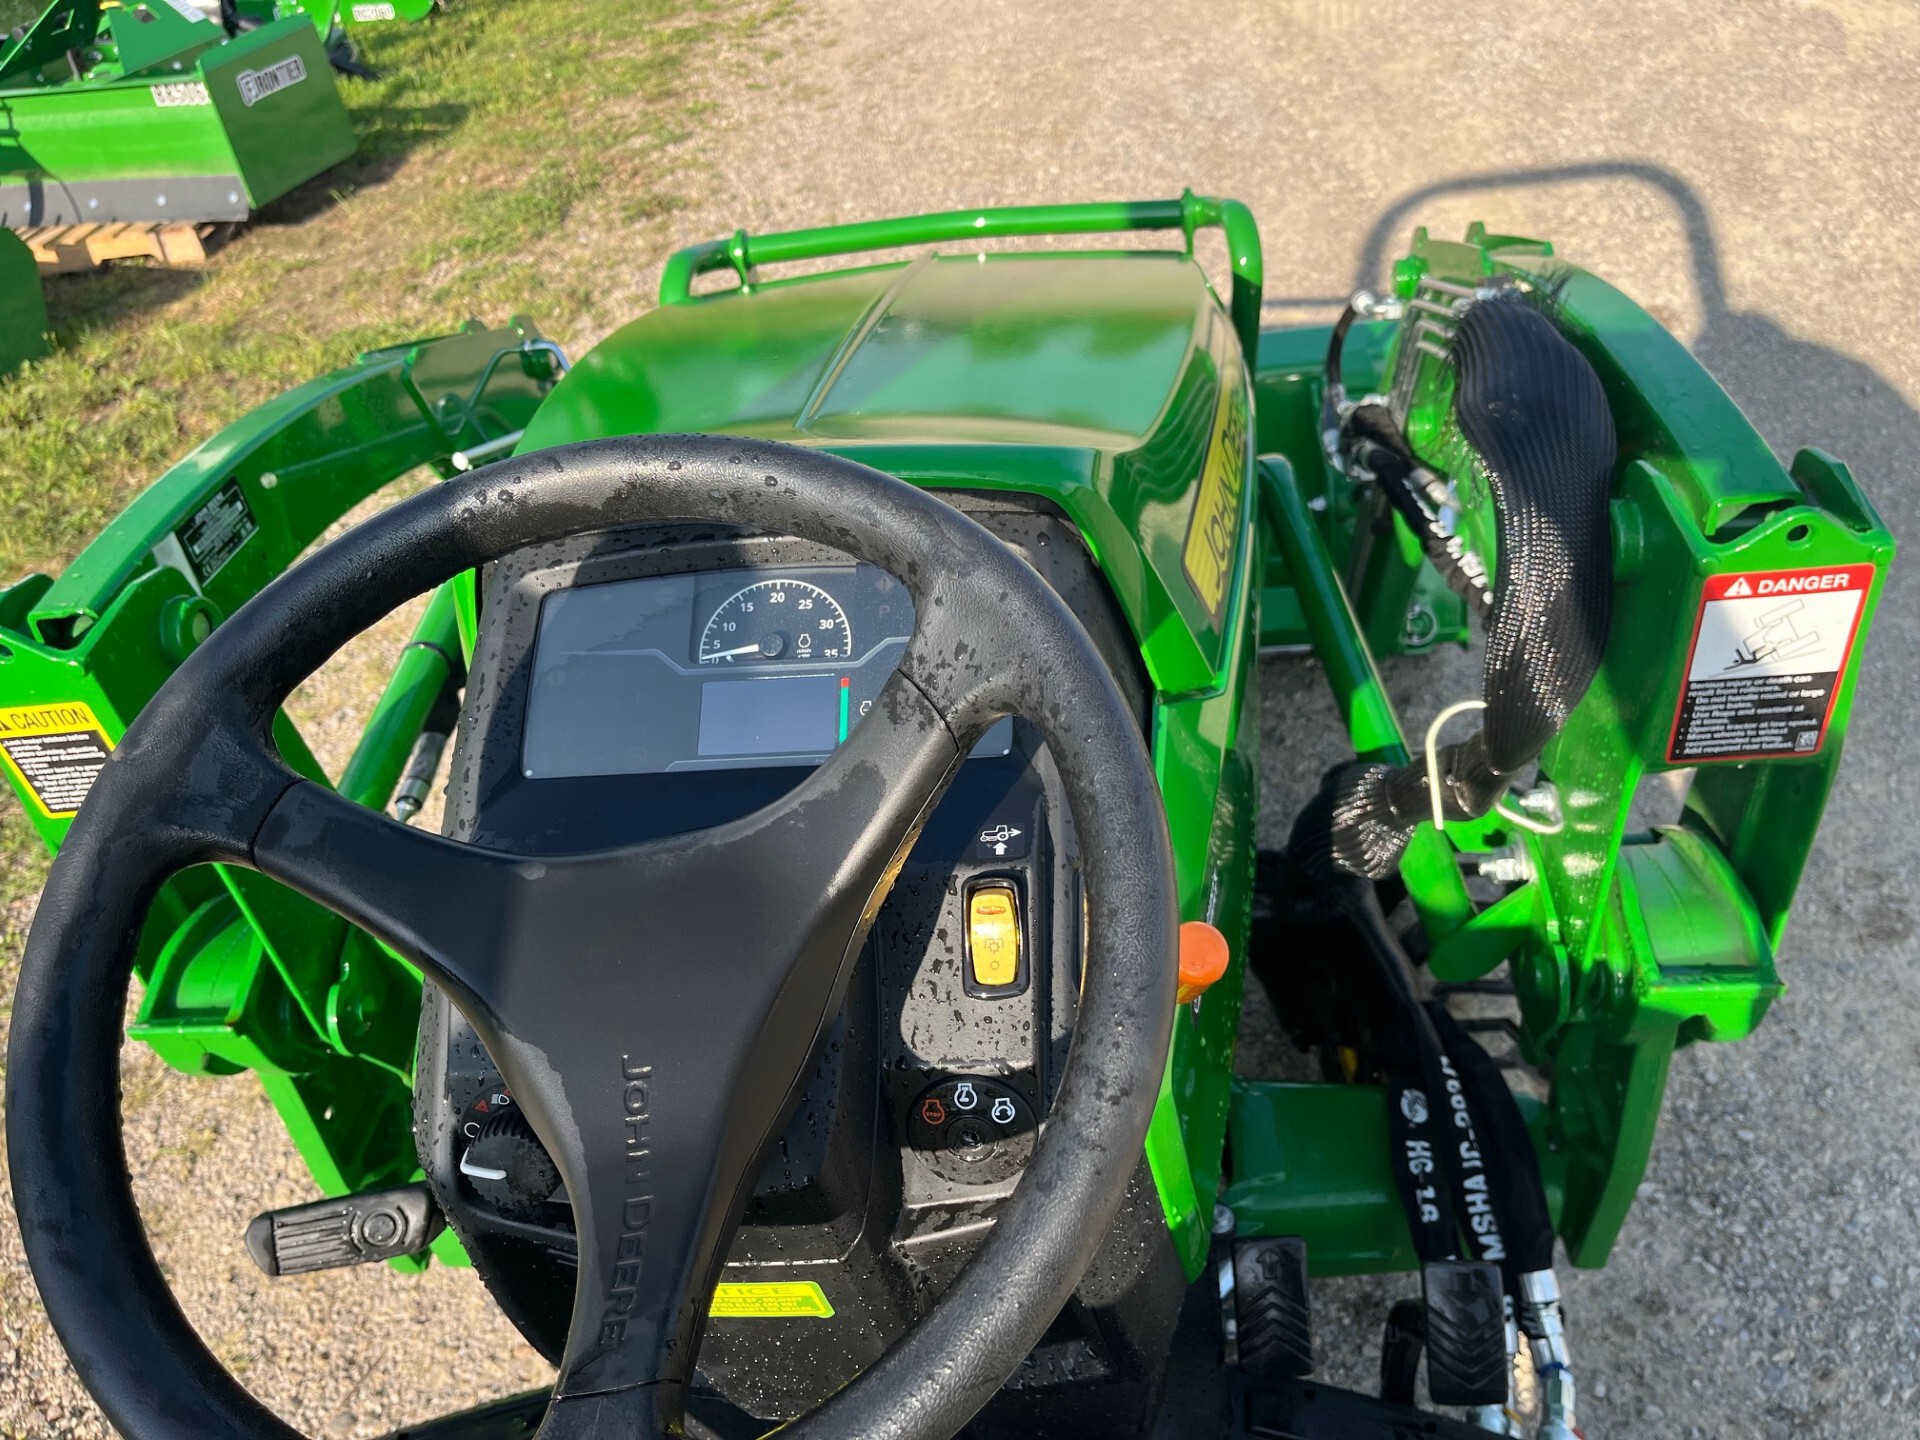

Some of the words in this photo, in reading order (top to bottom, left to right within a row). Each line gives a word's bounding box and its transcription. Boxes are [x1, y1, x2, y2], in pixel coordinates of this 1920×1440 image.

[1757, 573, 1850, 594] DANGER
[770, 592, 786, 603] 20
[740, 602, 754, 613] 15
[798, 599, 813, 610] 25
[722, 622, 736, 632] 10
[819, 618, 834, 630] 30
[713, 640, 721, 649] 5
[824, 648, 838, 658] 35
[1766, 676, 1792, 684] death
[1801, 689, 1825, 698] large
[9, 707, 91, 729] CAUTION
[1462, 1173, 1507, 1261] MSHA
[600, 1194, 655, 1345] DEERE
[719, 1287, 795, 1295] TICE
